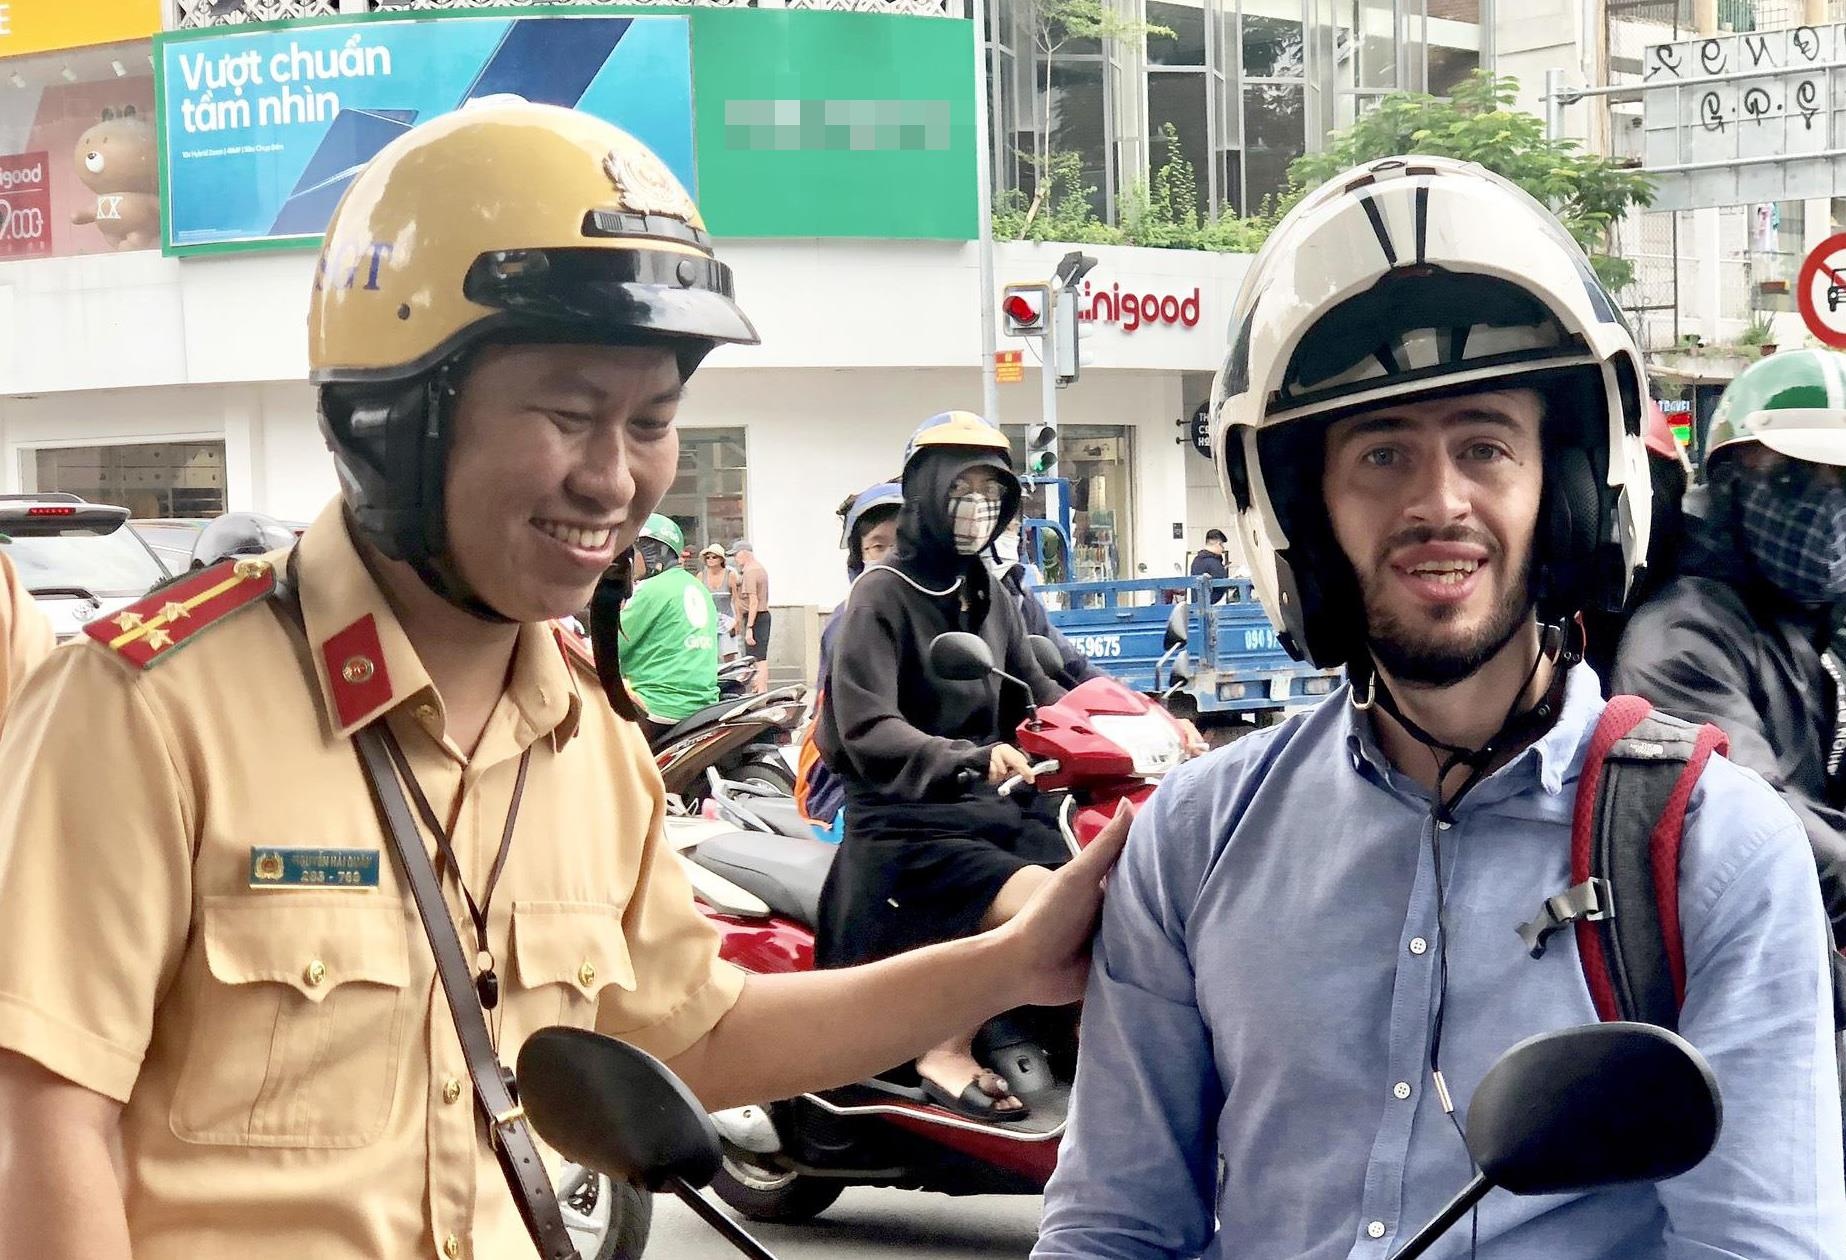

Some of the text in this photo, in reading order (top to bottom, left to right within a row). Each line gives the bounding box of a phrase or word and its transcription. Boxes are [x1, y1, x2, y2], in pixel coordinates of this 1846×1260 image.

[179, 50, 263, 96] Vượt
[181, 85, 340, 133] tầm nhìn
[1078, 281, 1199, 331] inigood
